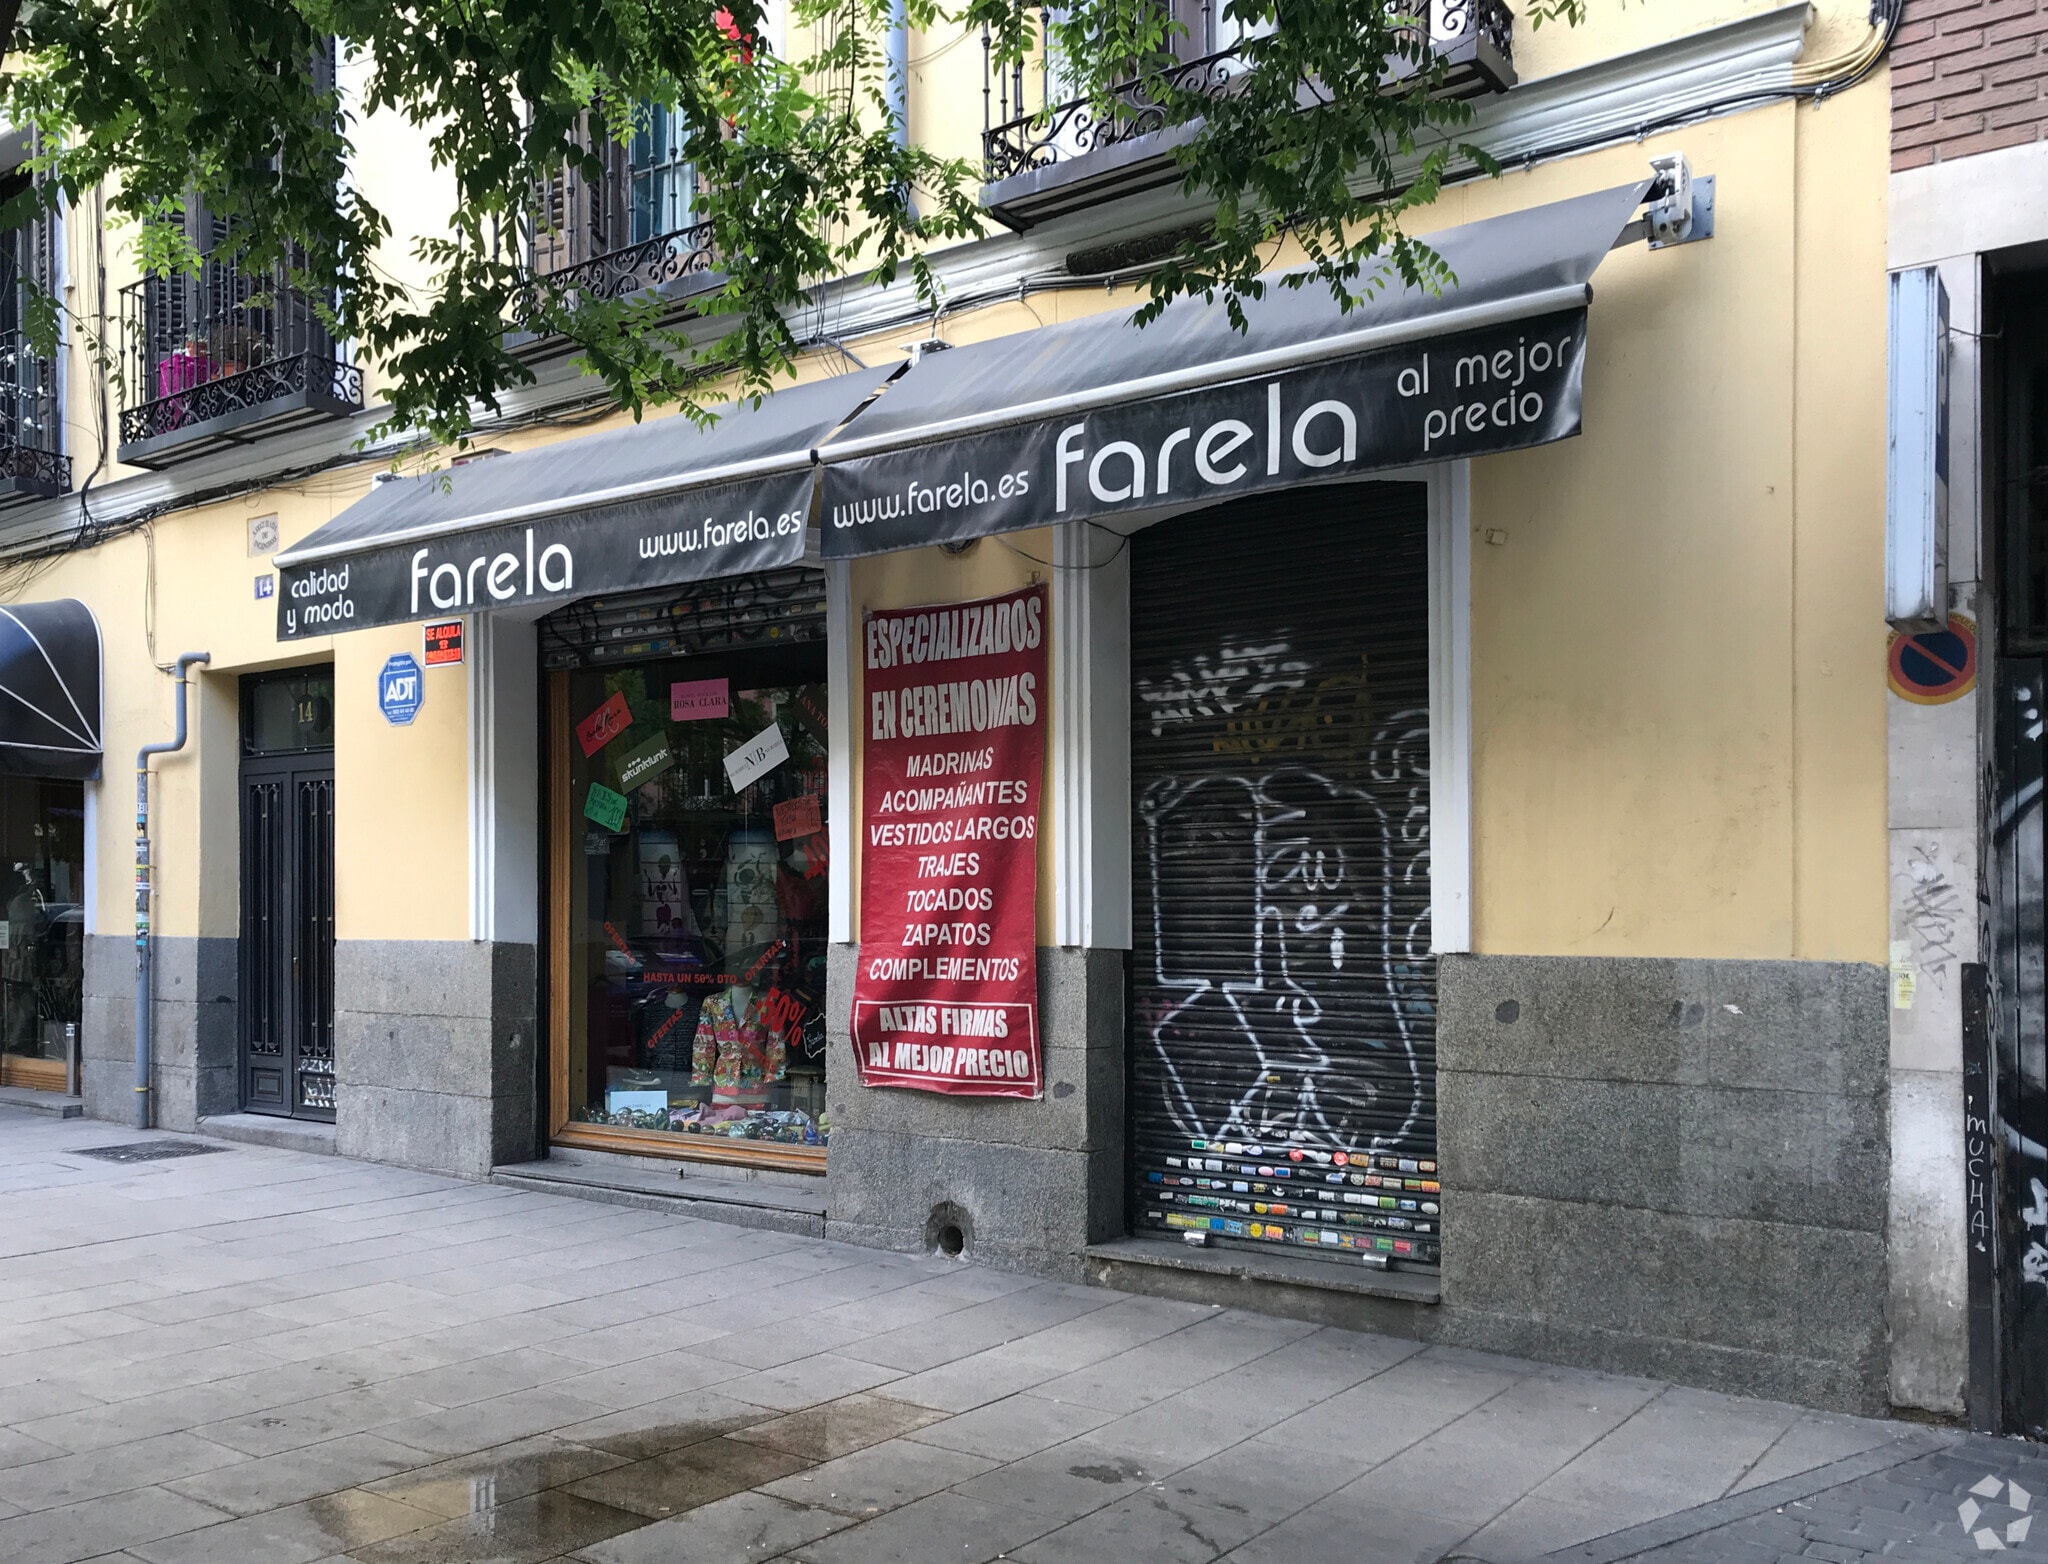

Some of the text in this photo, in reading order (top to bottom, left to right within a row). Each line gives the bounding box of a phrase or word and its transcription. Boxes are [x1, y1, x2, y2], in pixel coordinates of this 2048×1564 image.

[1397, 335, 1571, 398] al mejor
[1424, 389, 1543, 452] precio
[1055, 382, 1357, 513] farela
[833, 470, 1029, 529] www.farela.es
[639, 509, 801, 559] www.farela.es
[259, 578, 272, 597] 14
[291, 564, 349, 599] calidad
[411, 528, 574, 614] farela
[286, 594, 354, 634] y moda
[426, 624, 461, 641] SE ALQUILA
[867, 596, 1041, 669] ESPECIALIZADOS
[385, 676, 416, 702] ADT
[673, 696, 727, 709] ROSA CLARA
[872, 672, 1037, 740] EN CEREMONIAS
[299, 701, 313, 723] 14
[621, 748, 668, 783] skunkfunk
[906, 747, 994, 778] MADRINAS
[879, 780, 1028, 813] ACOMPAÑANTES
[870, 815, 1035, 846] VESTIDOS LARGOS
[918, 852, 980, 878] TRAJES
[906, 888, 993, 913] TOCADOS
[603, 921, 636, 966] OFERTAS
[902, 923, 991, 946] ZAPATOS
[643, 972, 737, 985] HASTA UN 50% DTO
[744, 939, 784, 983] OFERTAS
[869, 958, 1019, 982] COMPLEMENTOS
[646, 1008, 684, 1049] OFERTAS
[755, 986, 808, 1047] -50%
[879, 1005, 1009, 1038] ALTAS FIRMAS
[868, 1041, 1029, 1078] AL MEJOR PRECIO
[1966, 1114, 1989, 1238] MUCHA
